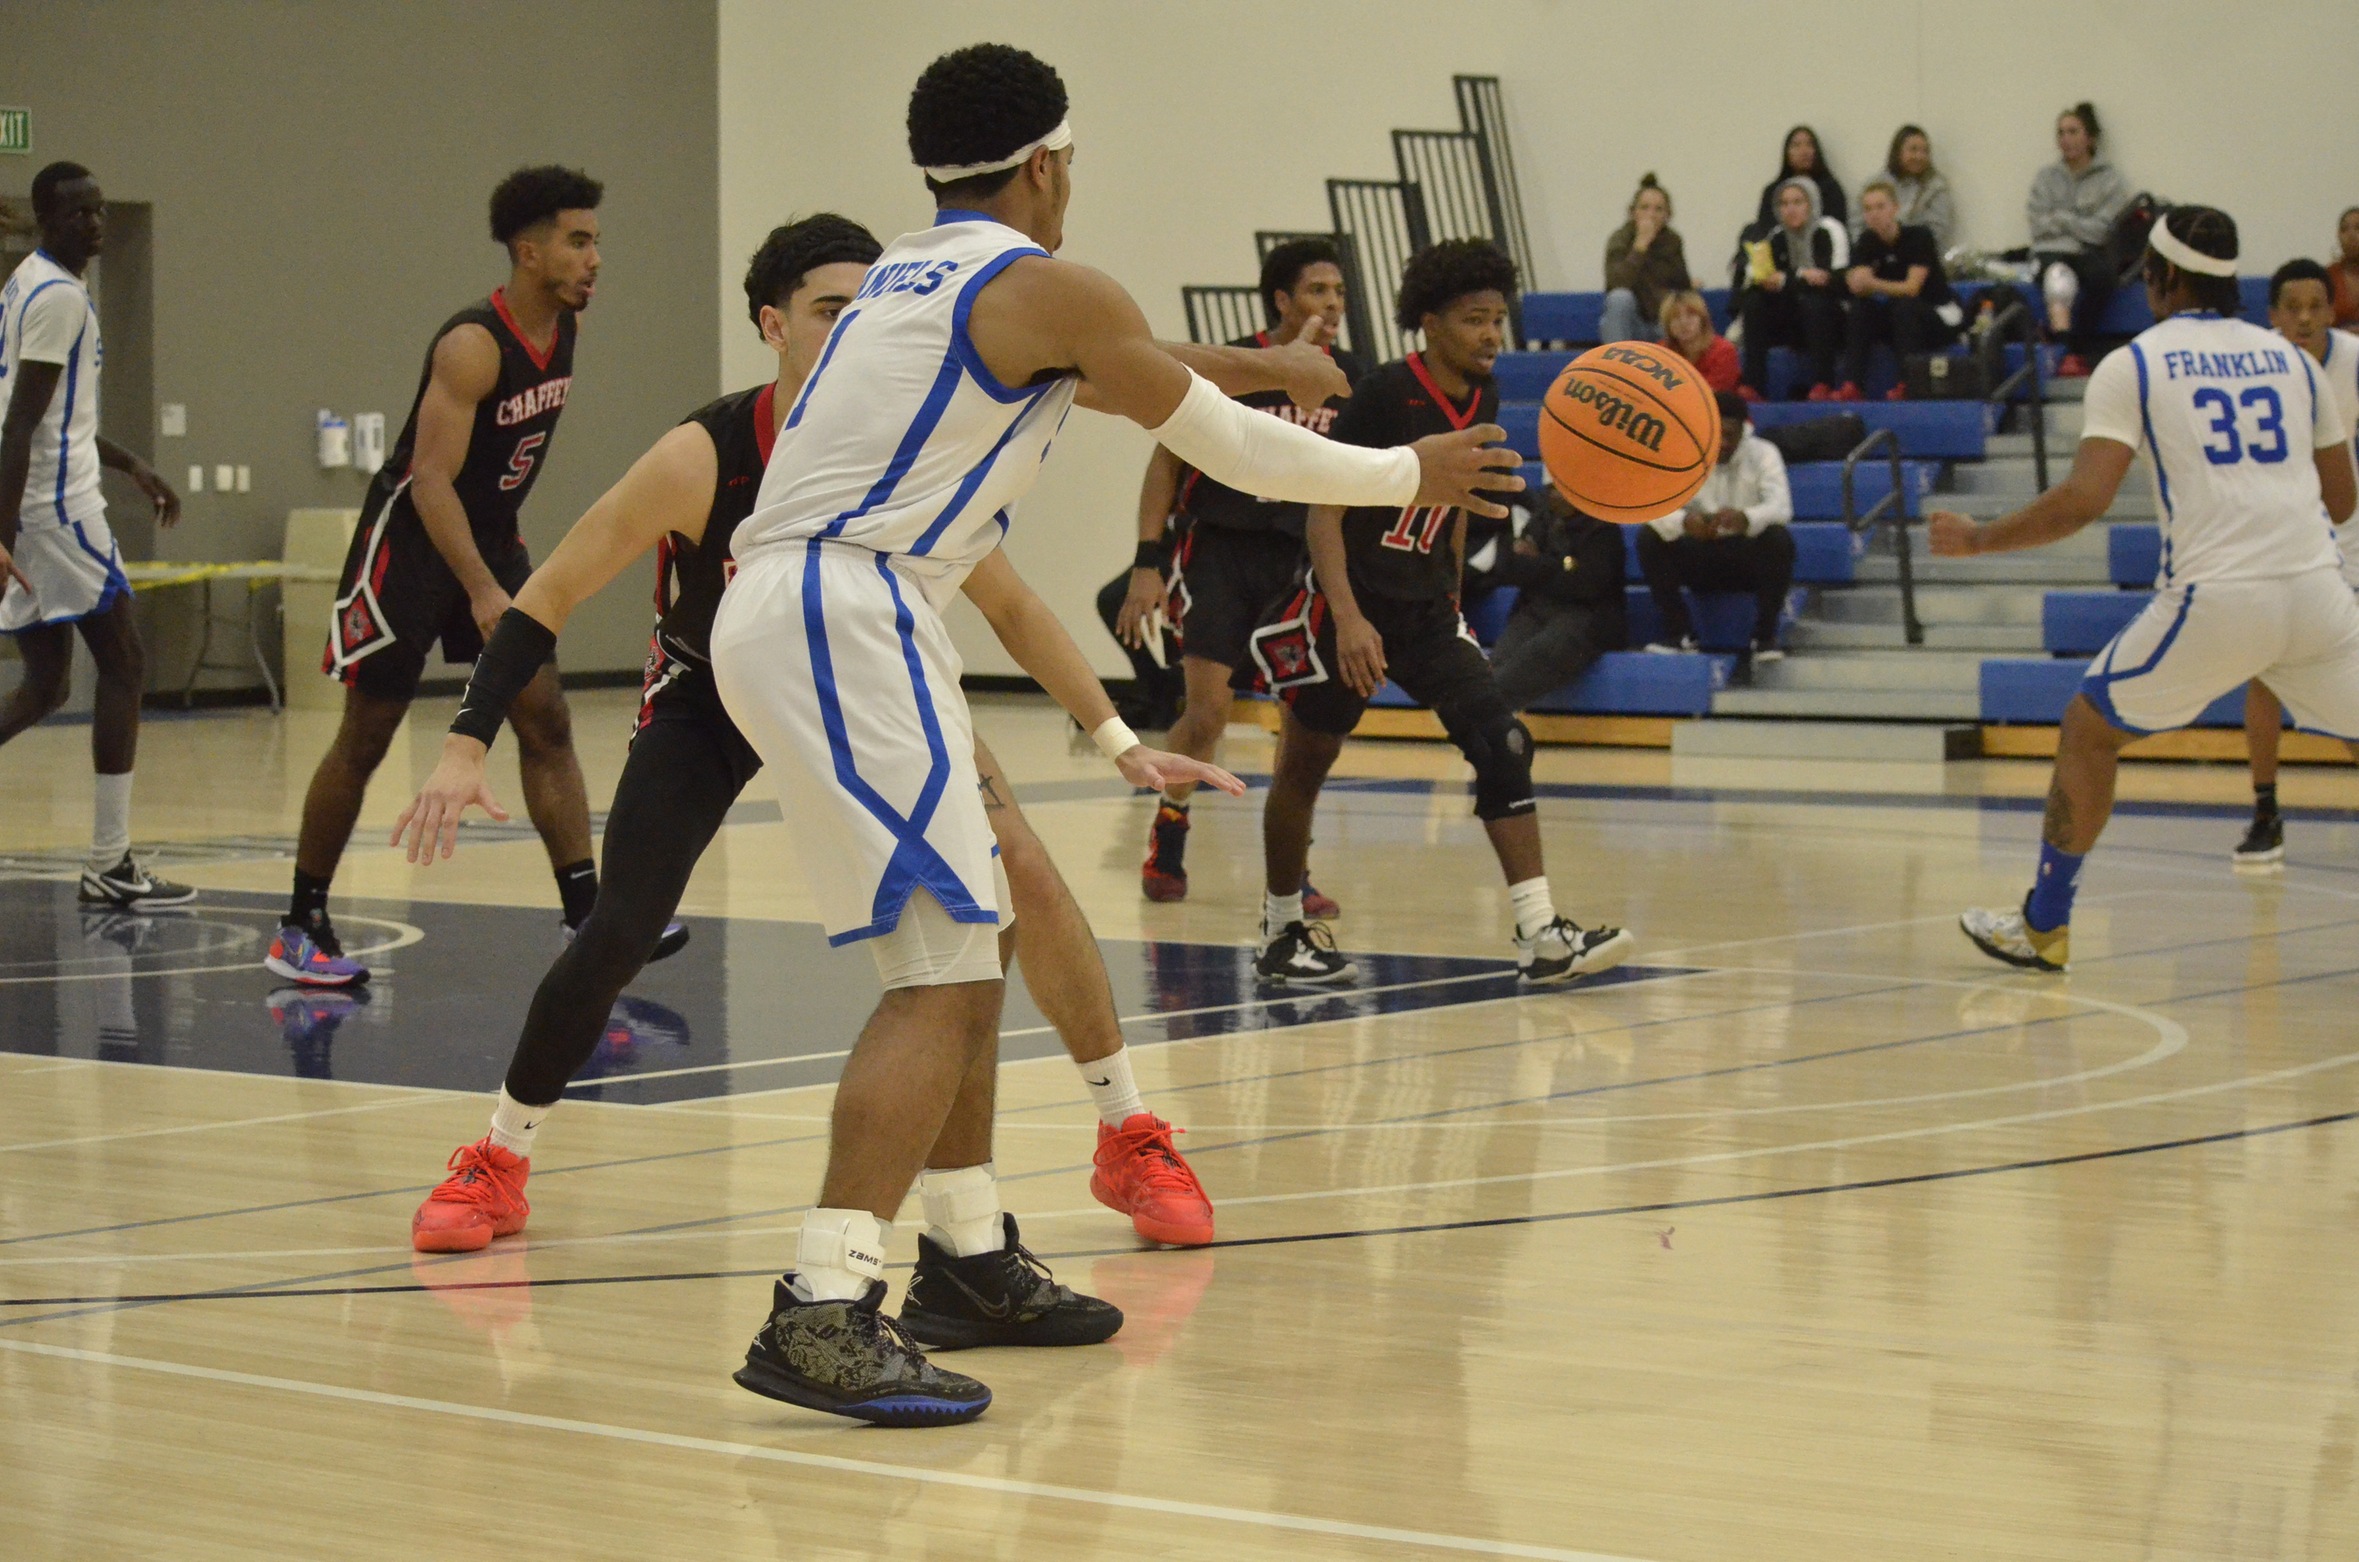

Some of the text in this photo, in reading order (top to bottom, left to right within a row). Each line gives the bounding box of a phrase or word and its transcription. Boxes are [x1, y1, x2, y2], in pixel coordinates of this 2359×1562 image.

[785, 309, 862, 431] 1
[1602, 347, 1684, 391] NCAA
[2164, 350, 2290, 380] FRANKLIN
[1564, 378, 1667, 452] Wilson
[2193, 386, 2288, 465] 33
[499, 431, 546, 491] 5
